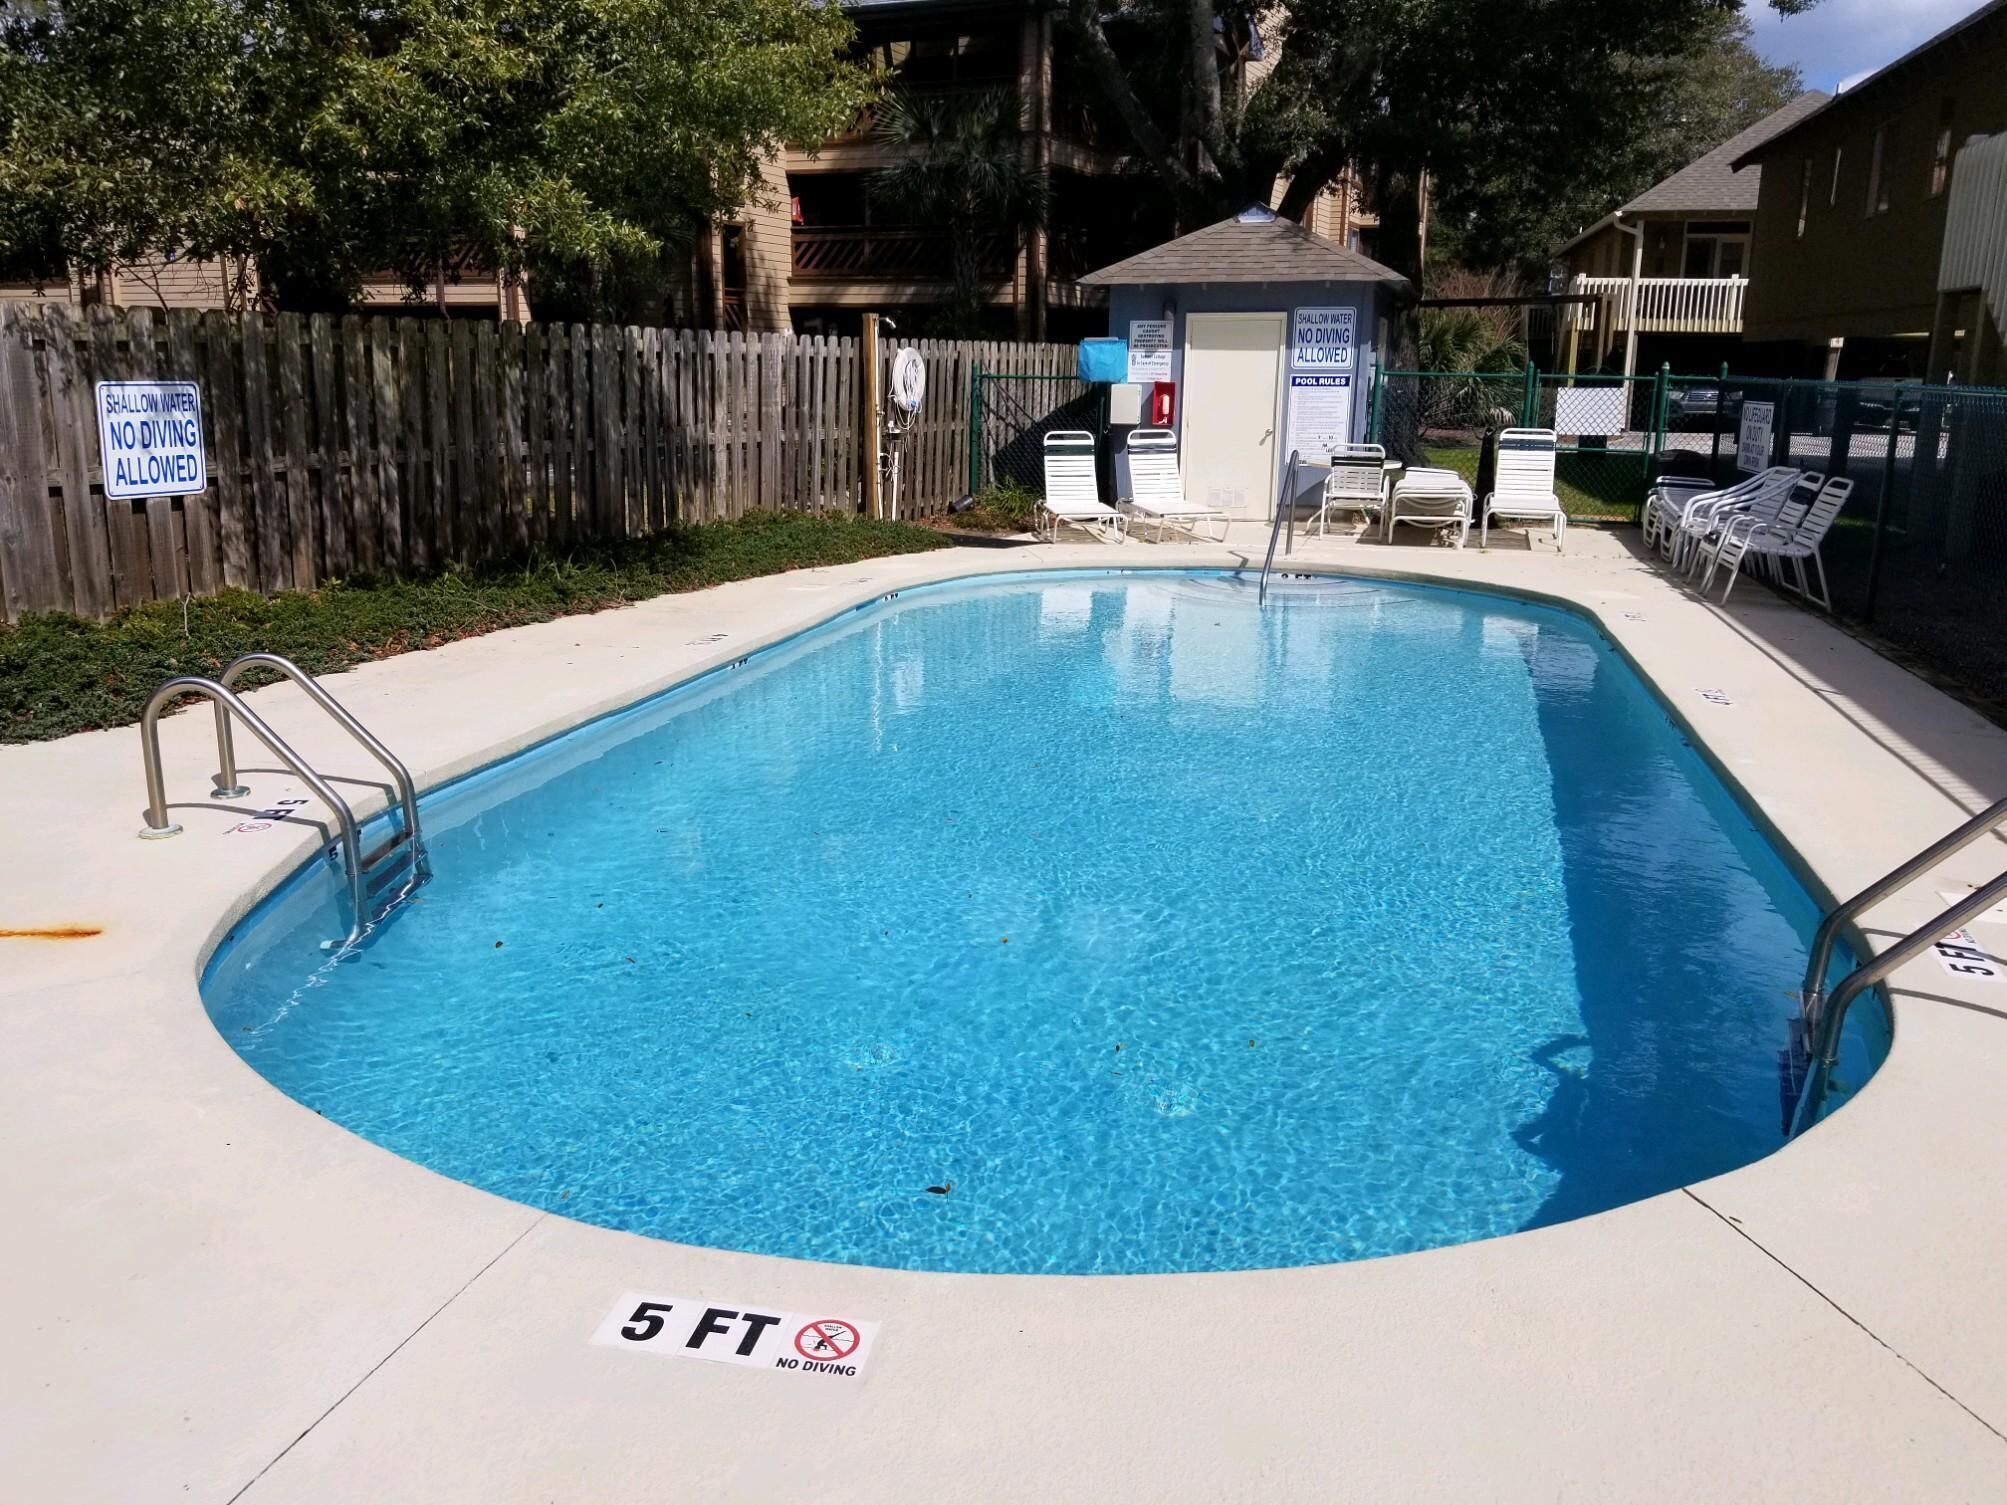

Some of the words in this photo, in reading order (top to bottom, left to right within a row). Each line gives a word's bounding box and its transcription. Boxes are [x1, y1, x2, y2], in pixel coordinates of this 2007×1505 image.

[1298, 313, 1329, 324] SHALLOW
[1330, 313, 1353, 324] WATER
[1298, 328, 1313, 344] NO
[1315, 328, 1350, 344] DIVING
[1297, 347, 1348, 363] ALLOWED
[1295, 377, 1318, 386] POOL
[1319, 377, 1346, 386] RULES
[106, 393, 158, 414] SHALLOW
[160, 392, 196, 412] WATER
[110, 421, 136, 450] NO
[140, 419, 197, 449] DIVING
[116, 454, 198, 486] ALLOWED
[328, 846, 338, 861] 5
[1934, 941, 1985, 961] FT
[1949, 963, 1994, 976] 5
[620, 1302, 673, 1341] 5
[685, 1308, 782, 1356] FT
[776, 1357, 799, 1370] NO
[802, 1360, 857, 1376] DIVING
